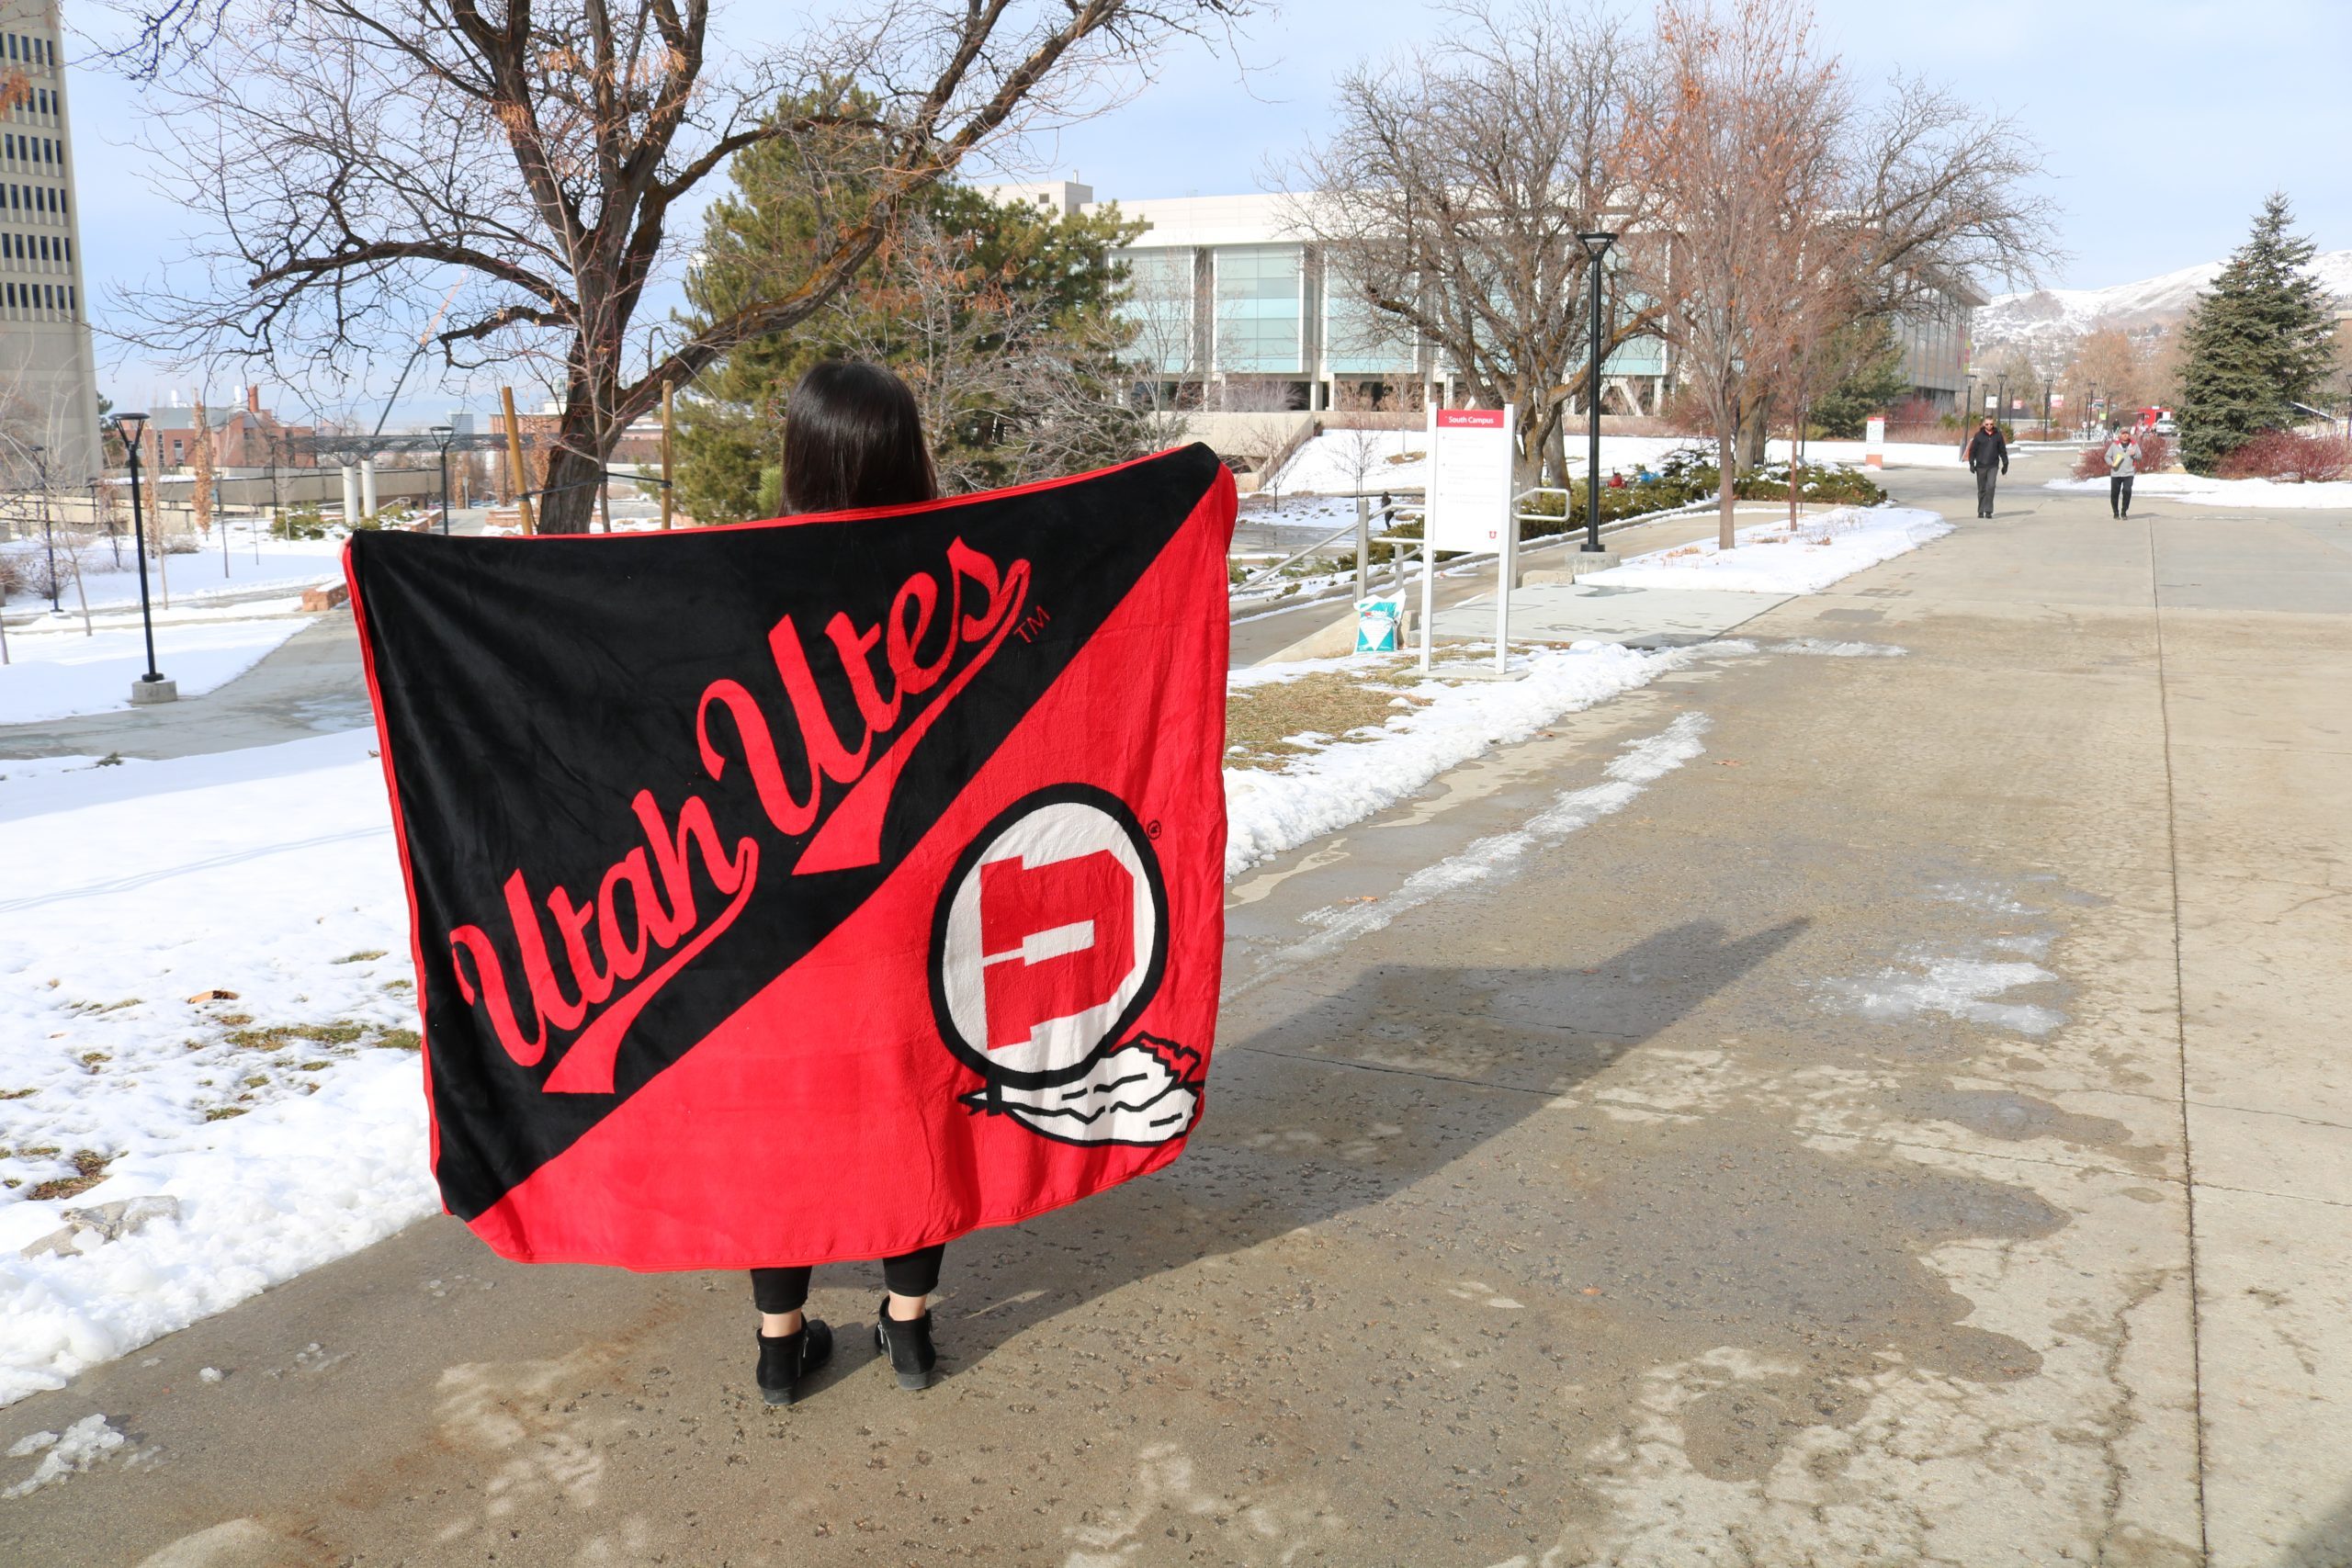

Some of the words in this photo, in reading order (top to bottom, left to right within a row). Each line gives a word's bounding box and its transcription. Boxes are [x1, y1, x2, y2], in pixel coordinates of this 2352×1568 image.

[1448, 415, 1467, 424] South
[1468, 416, 1493, 425] Campus
[448, 788, 760, 1094] Utah
[695, 535, 1032, 875] Utes
